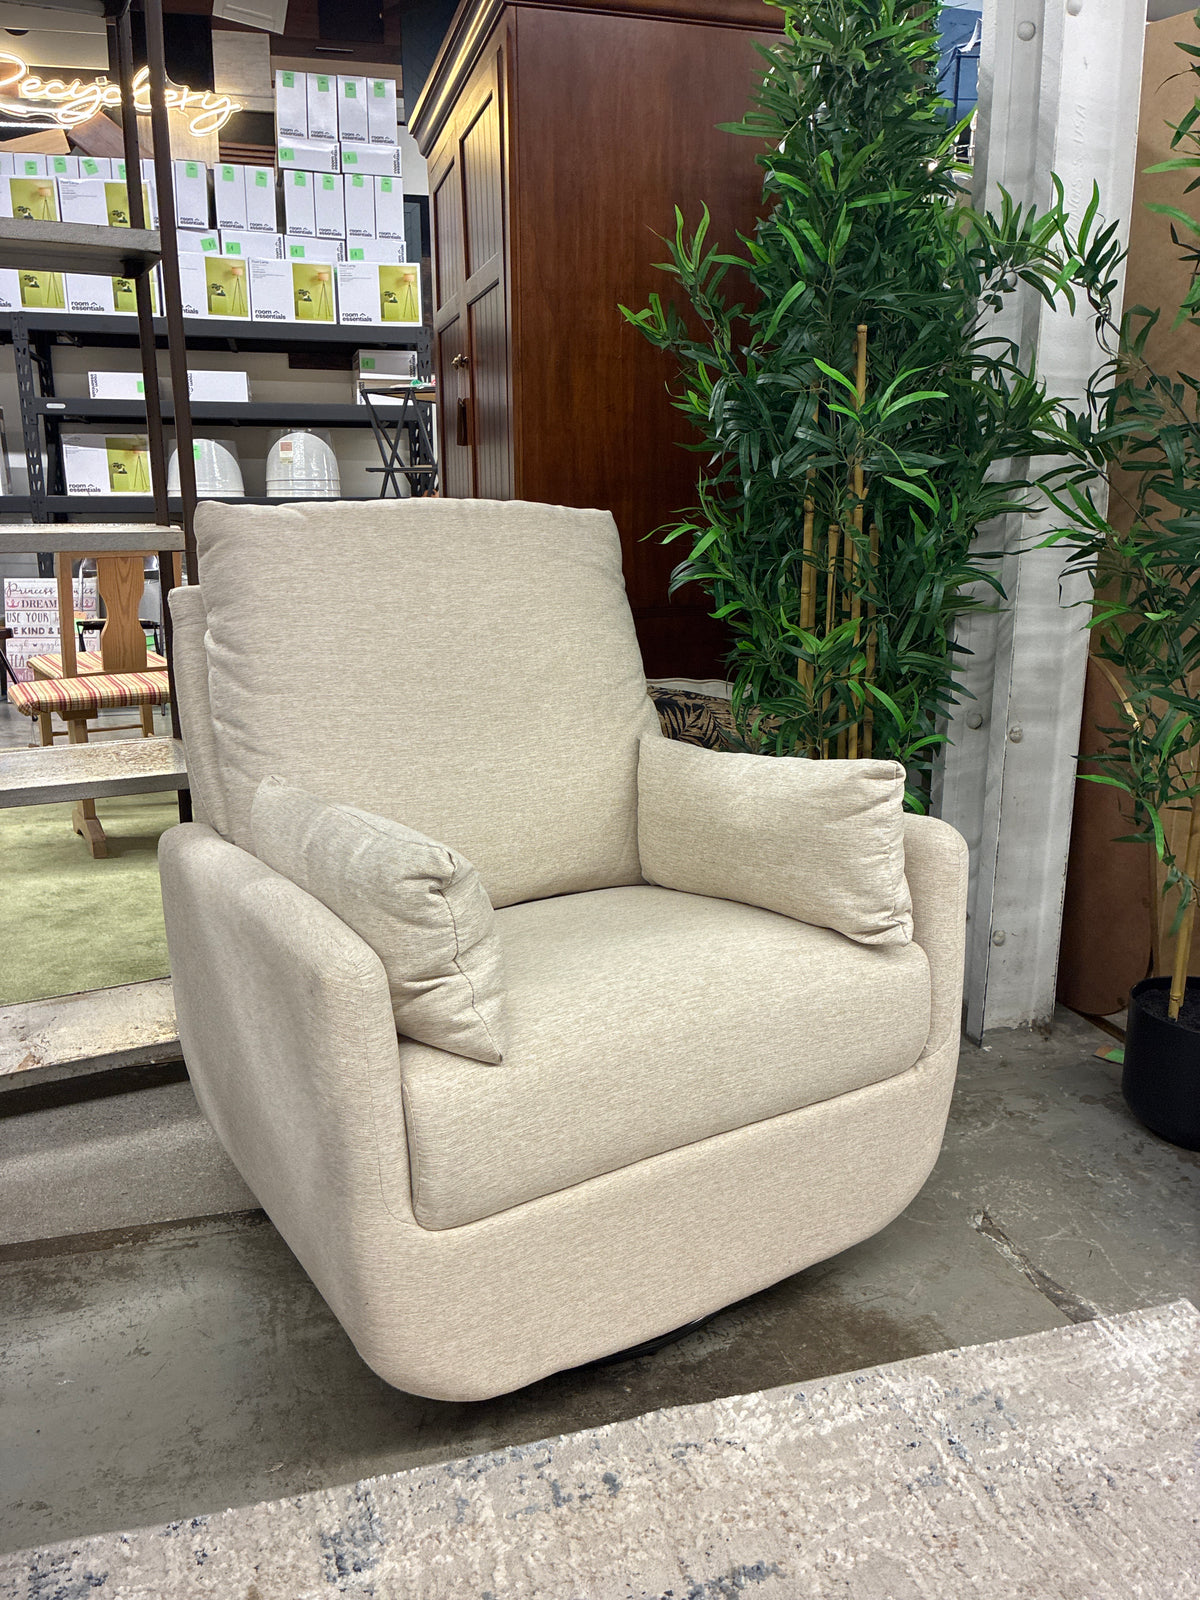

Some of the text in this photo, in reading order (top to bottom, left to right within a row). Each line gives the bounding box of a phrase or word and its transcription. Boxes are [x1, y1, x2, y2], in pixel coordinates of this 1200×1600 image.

[21, 600, 57, 608] DREAM
[6, 612, 20, 623] USE
[26, 612, 49, 623] YOUR
[10, 654, 24, 667] TEA
